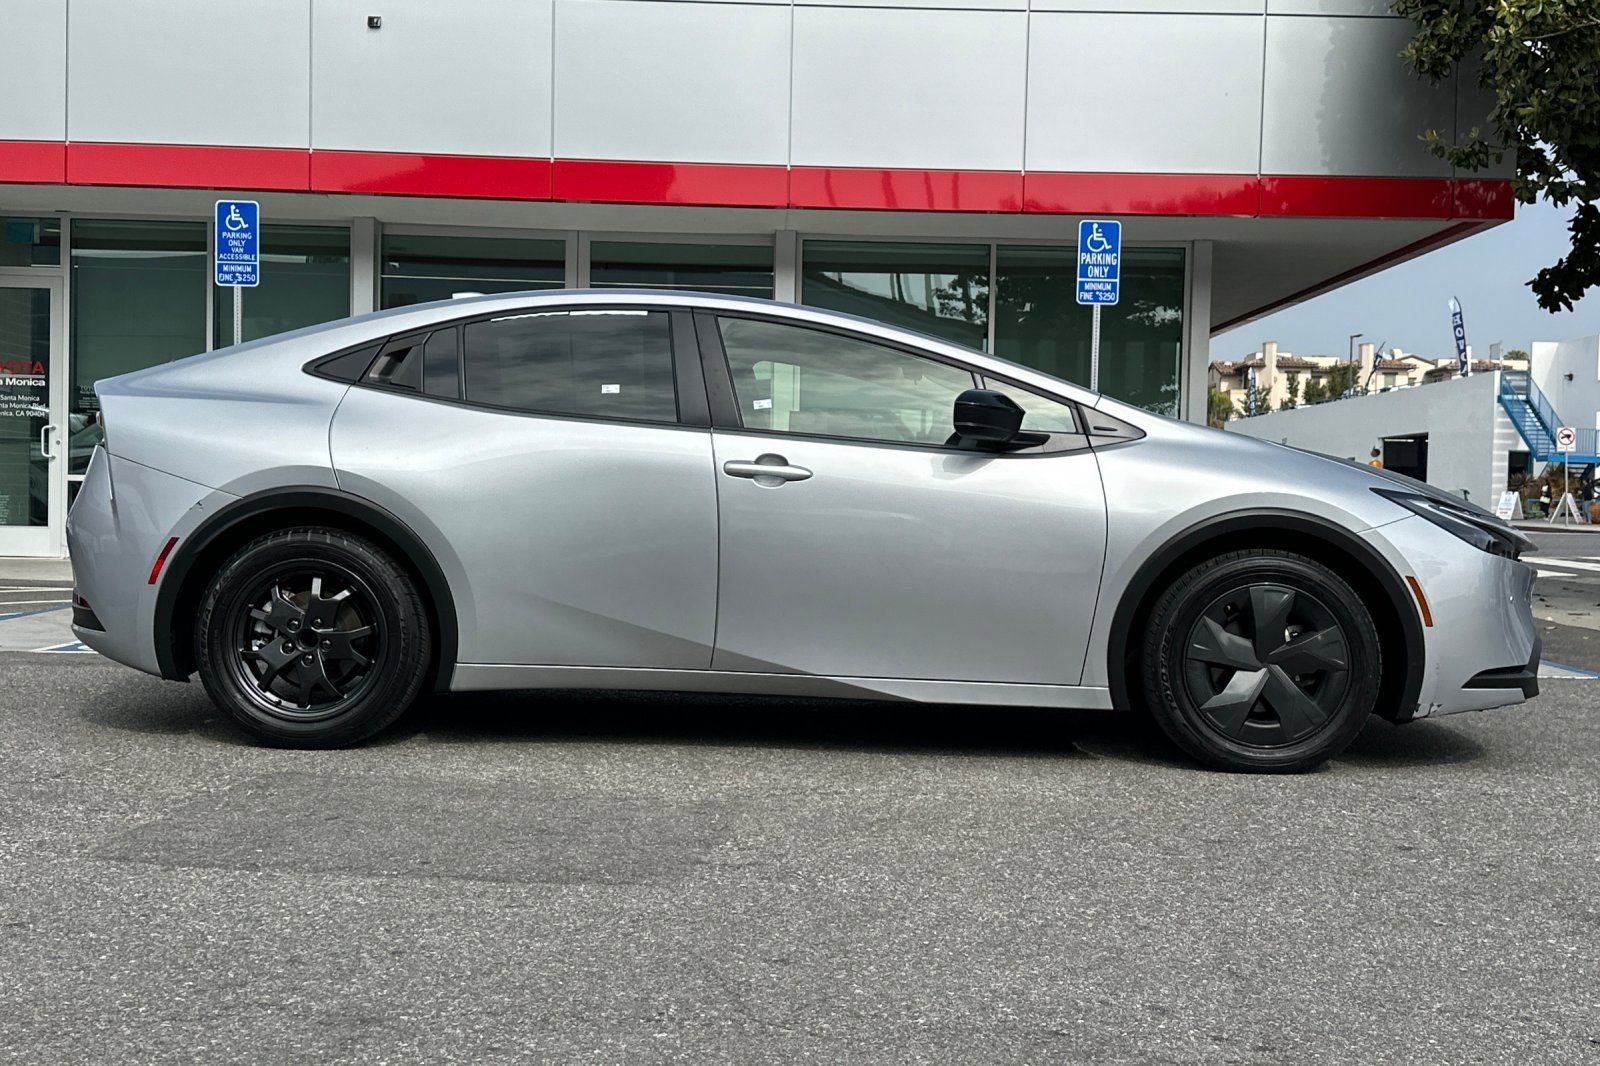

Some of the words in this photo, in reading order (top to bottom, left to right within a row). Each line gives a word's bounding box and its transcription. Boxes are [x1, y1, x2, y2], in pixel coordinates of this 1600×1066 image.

[219, 253, 255, 261] ACCESSIBLE
[1081, 252, 1118, 265] PARKING
[1087, 265, 1109, 277] ONLY
[1084, 282, 1111, 290] MINIMUM
[1079, 291, 1093, 300] FINE
[5, 377, 46, 387] Monica
